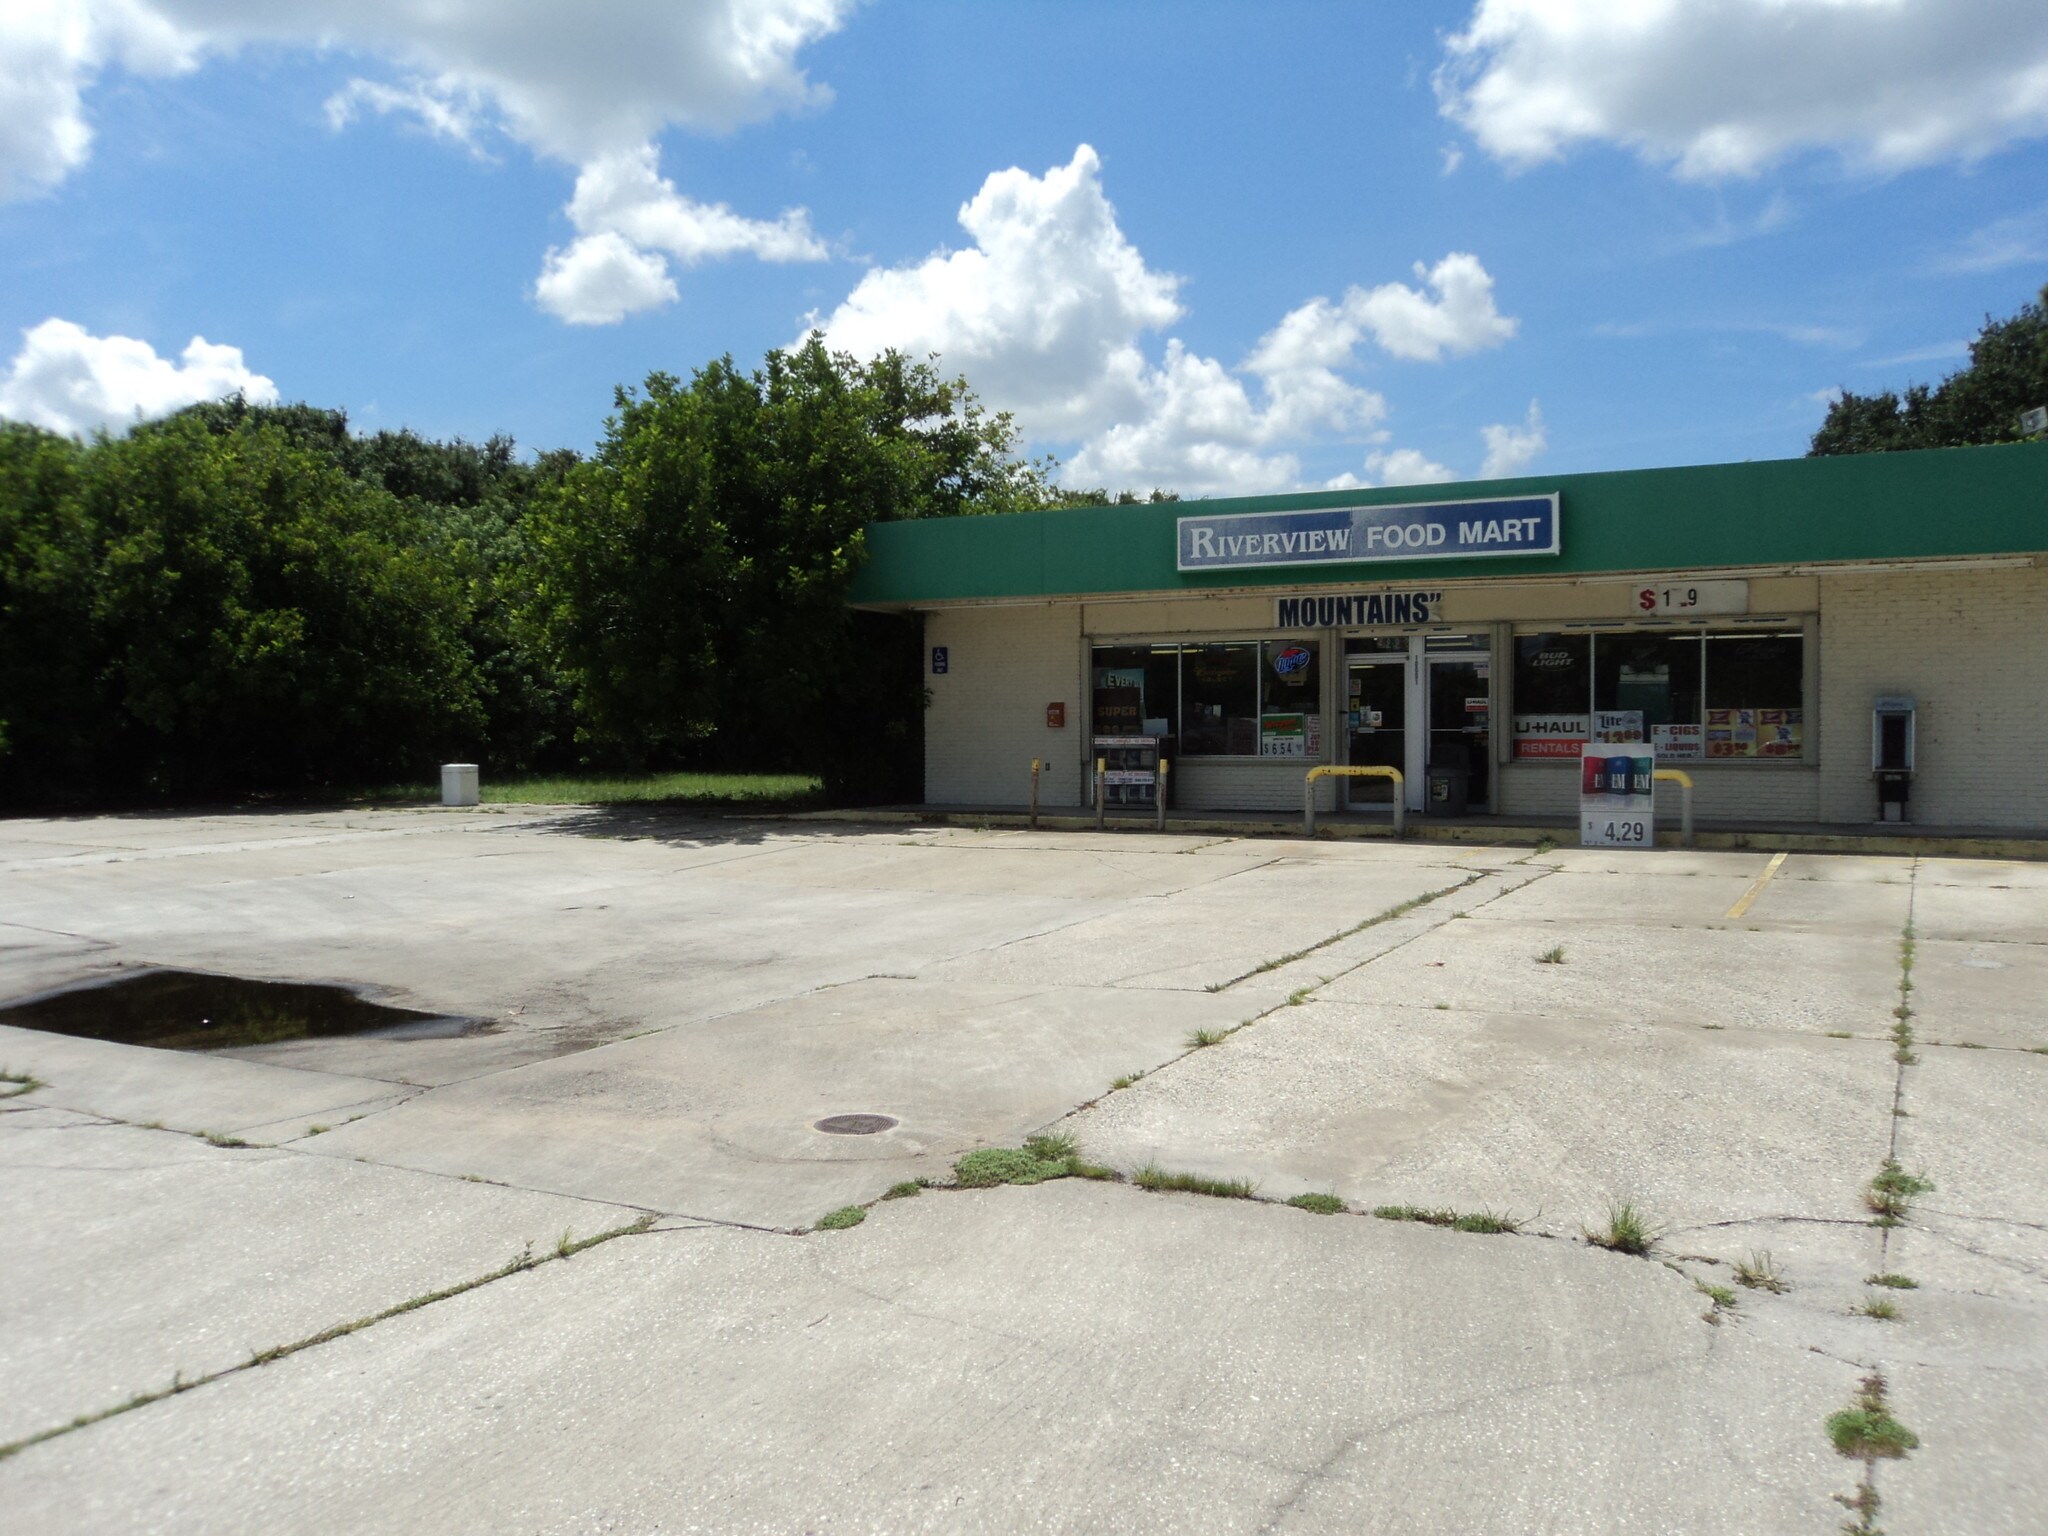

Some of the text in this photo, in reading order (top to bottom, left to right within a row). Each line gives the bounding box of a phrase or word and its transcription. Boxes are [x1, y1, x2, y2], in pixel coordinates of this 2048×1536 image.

[1190, 518, 1541, 558] RIVERVIEW FOOD MART
[1538, 651, 1569, 659] BUD
[1532, 658, 1575, 667] LIGHT
[1096, 706, 1137, 717] SUPER
[1601, 715, 1622, 728] Lite
[1515, 722, 1585, 733] U-HAUL
[1670, 726, 1700, 735] CIGS
[1521, 743, 1580, 753] RENTALS
[1665, 743, 1700, 751] LIQUIDS
[1605, 822, 1644, 842] 4.29
